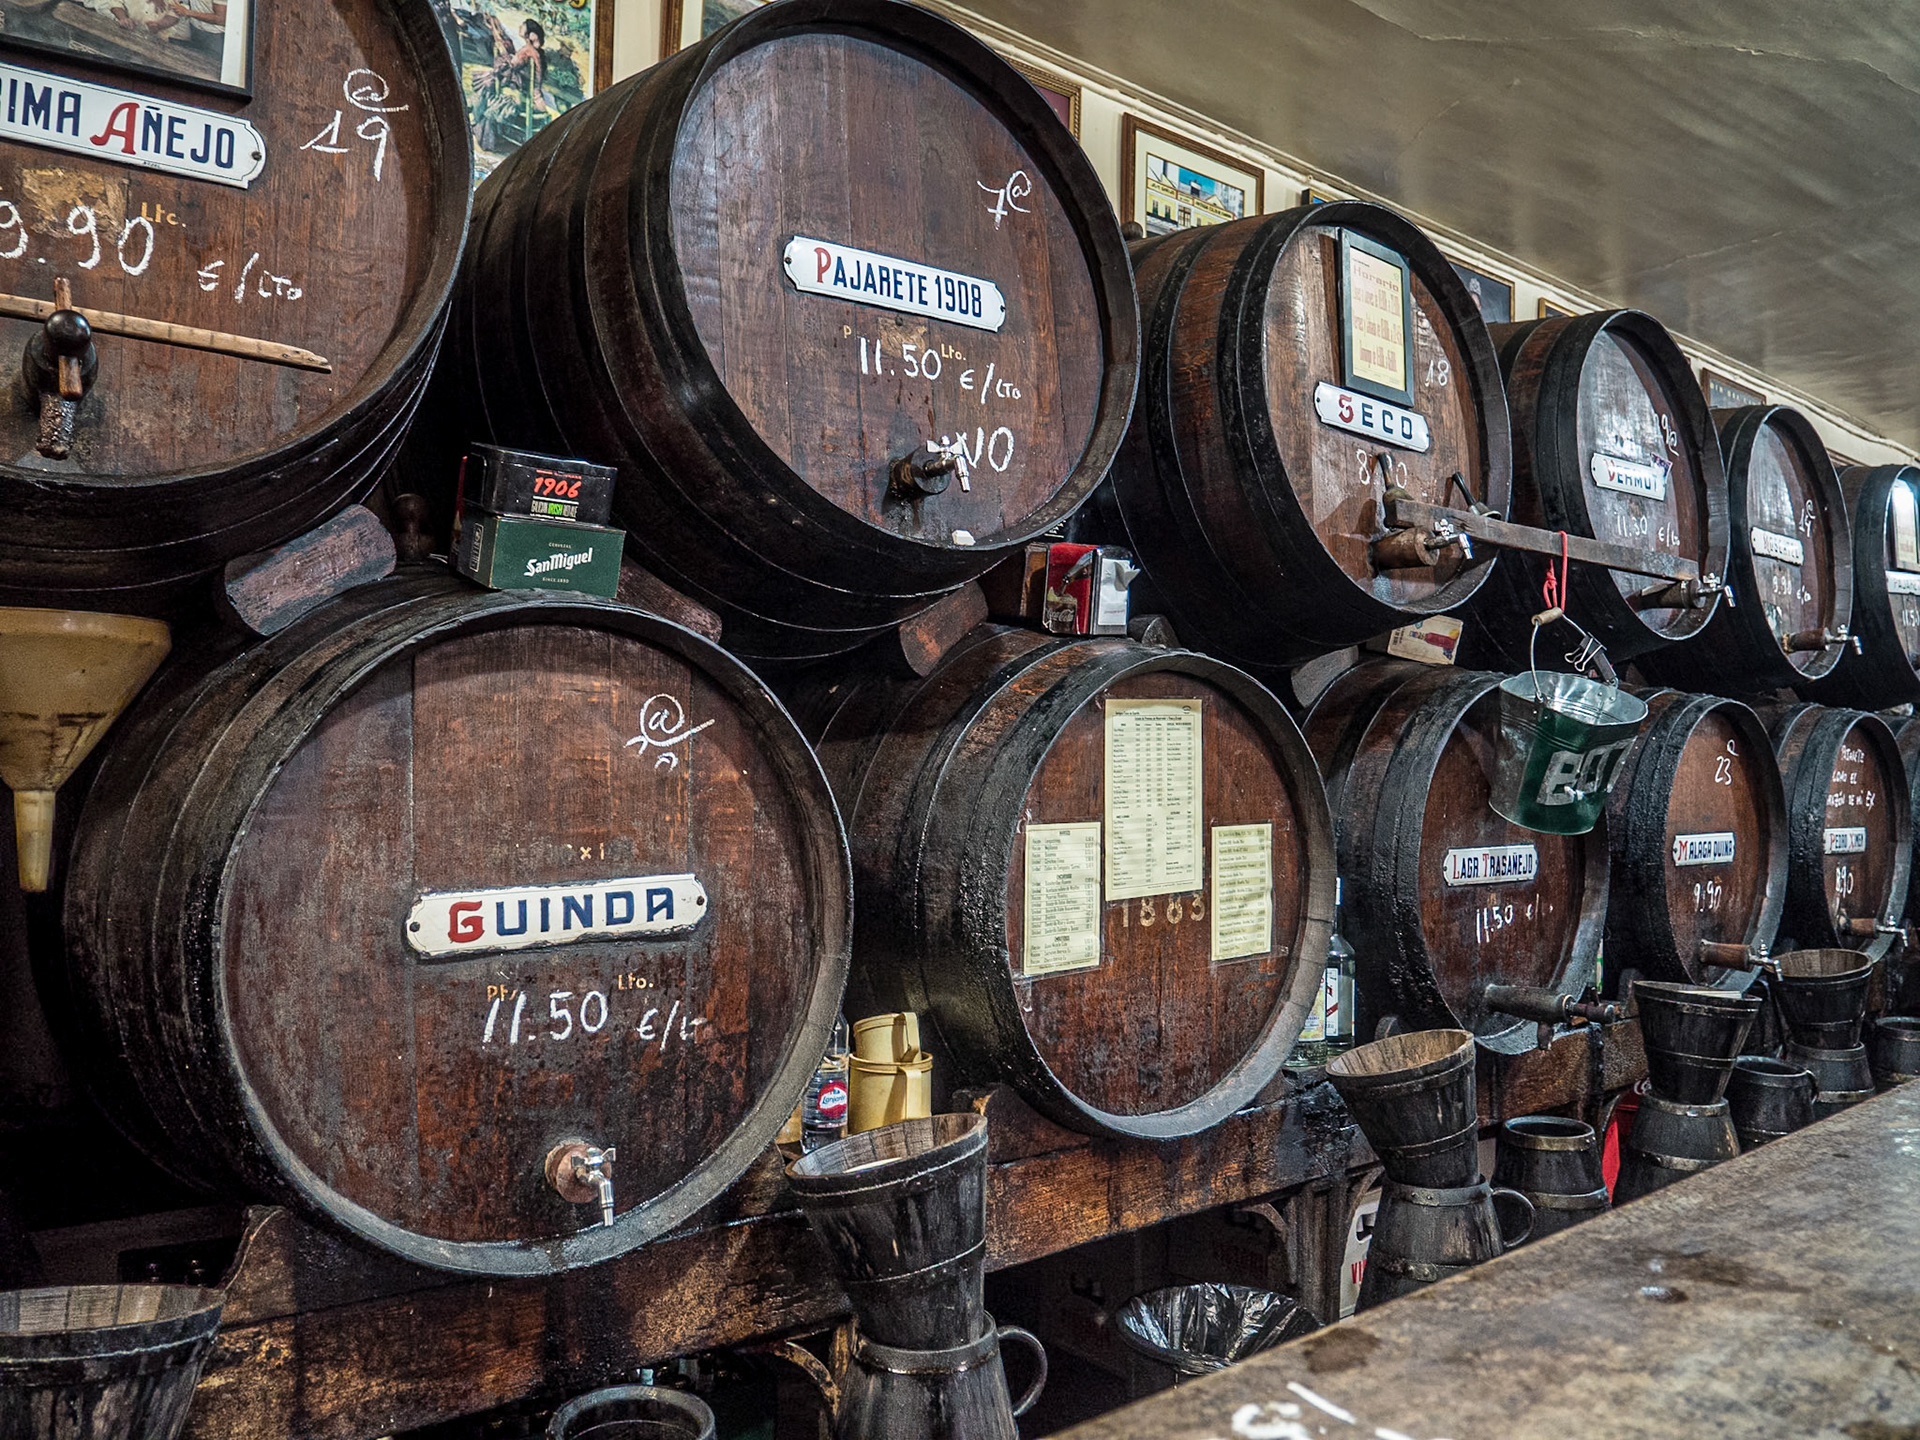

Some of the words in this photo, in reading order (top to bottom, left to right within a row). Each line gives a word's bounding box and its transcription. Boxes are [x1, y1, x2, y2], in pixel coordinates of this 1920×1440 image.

[0, 78, 81, 137] IMA
[90, 102, 235, 169] AÑEJO
[300, 110, 390, 182] 19
[814, 247, 928, 305] PAJARETE
[935, 274, 982, 318] 1908
[858, 337, 942, 380] 11.50
[1339, 394, 1412, 440] SECO
[534, 476, 582, 498] 1906
[1603, 458, 1658, 492] VERMUT
[1715, 755, 1732, 786] 23
[1482, 852, 1533, 877] TRASAÑEJO
[1678, 840, 1711, 861] MALAGA
[448, 887, 674, 943] GUINDA
[1476, 905, 1513, 943] 11.50
[482, 990, 608, 1049] 11.50
